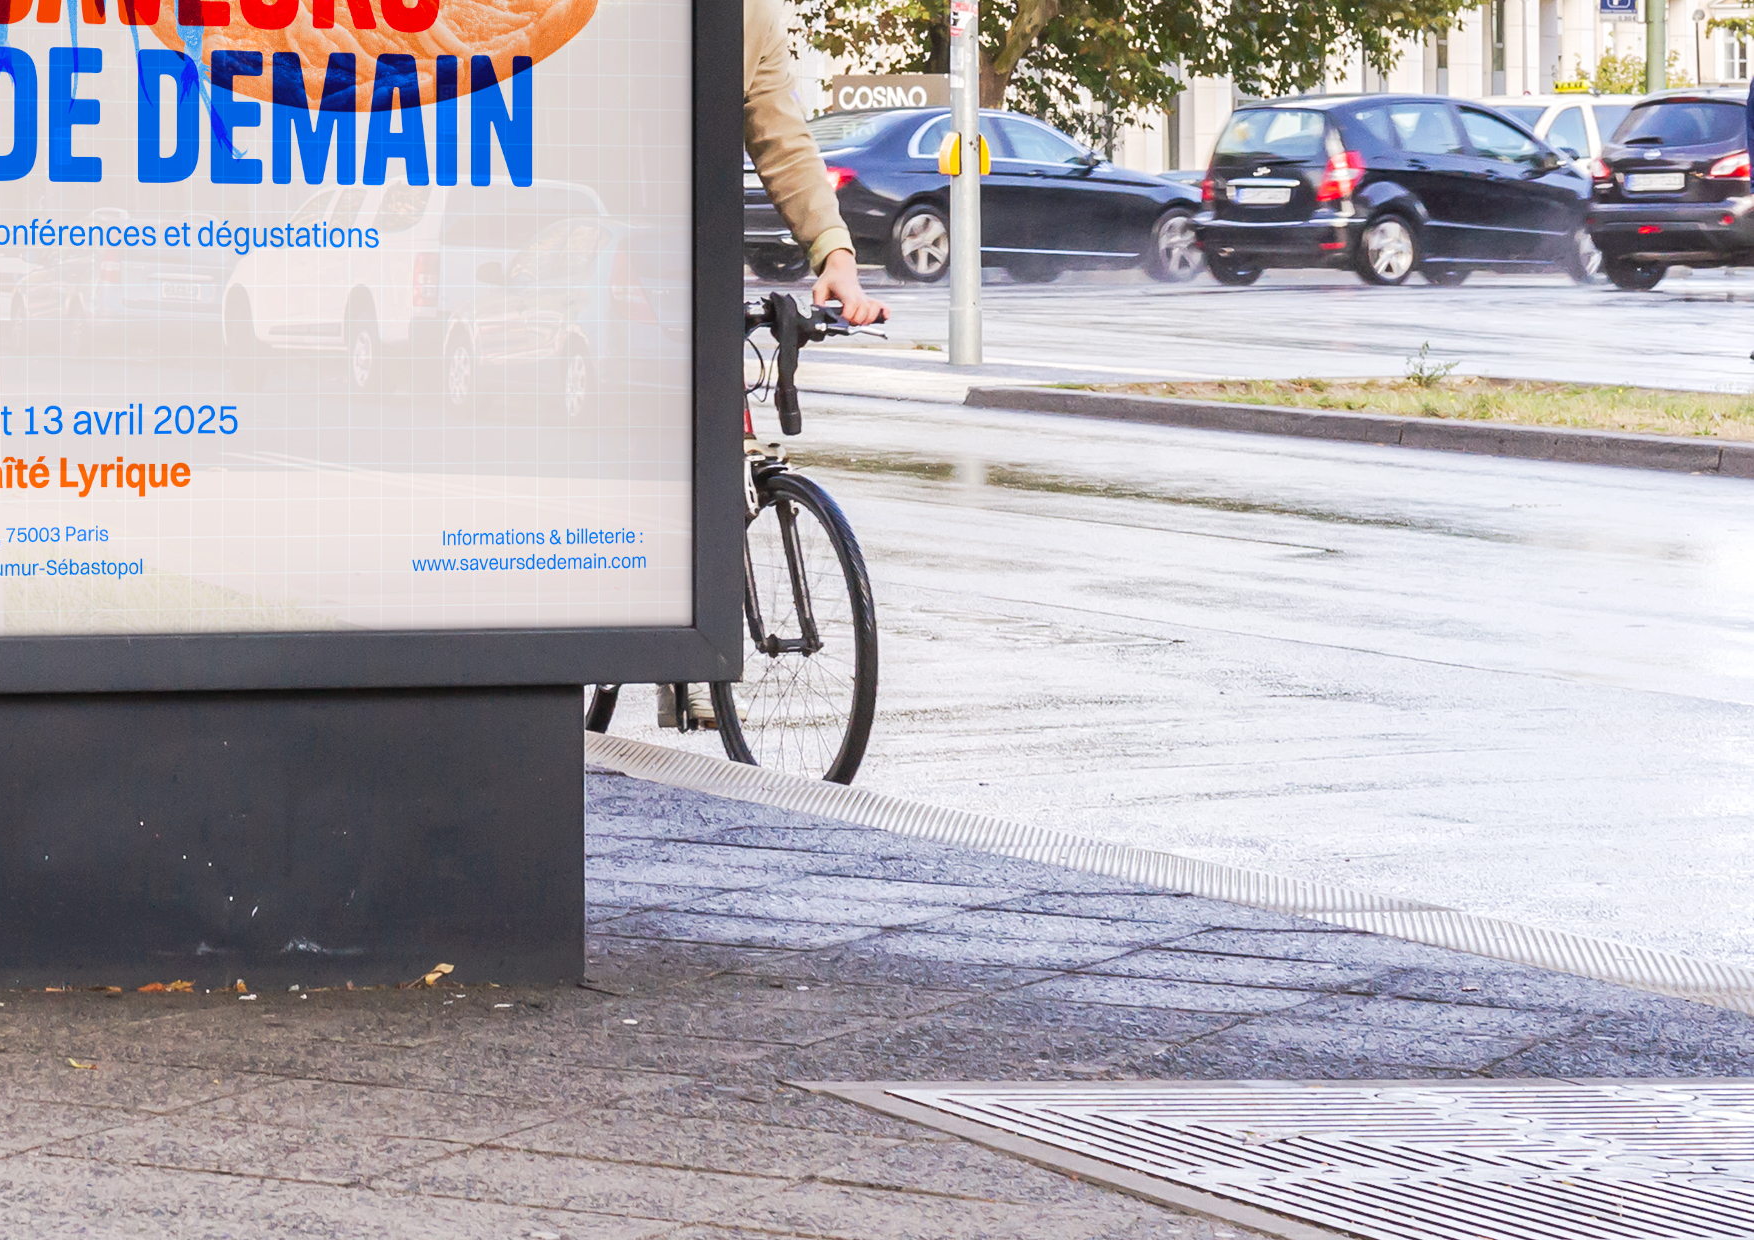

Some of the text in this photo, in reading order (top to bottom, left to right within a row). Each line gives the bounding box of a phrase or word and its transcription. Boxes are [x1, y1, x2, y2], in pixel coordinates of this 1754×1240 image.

[839, 85, 927, 110] COSMO
[137, 49, 533, 187] DEMAIN
[164, 223, 190, 247] et
[198, 220, 379, 255] dégustations
[25, 406, 63, 435] 13
[73, 403, 142, 435] avril
[154, 405, 238, 434] 2025
[60, 456, 191, 498] Lyrique
[6, 527, 60, 542] 75003
[66, 526, 108, 541] Paris
[443, 529, 545, 545] Informations
[567, 528, 635, 544] billeterie
[412, 553, 646, 571] www.saveursdedemain.com
